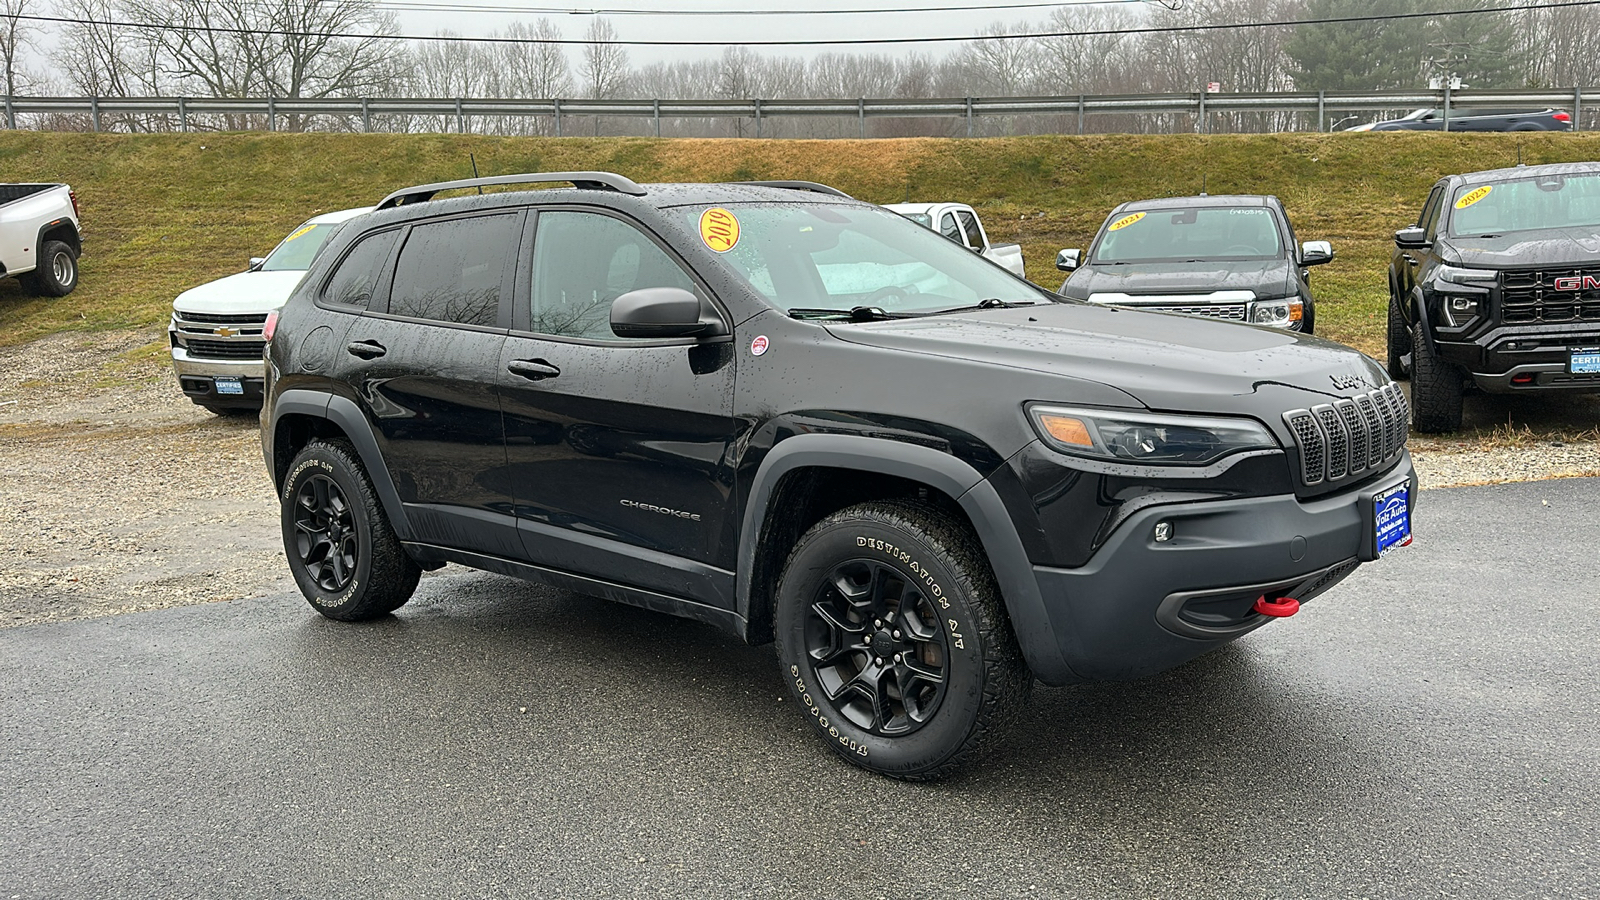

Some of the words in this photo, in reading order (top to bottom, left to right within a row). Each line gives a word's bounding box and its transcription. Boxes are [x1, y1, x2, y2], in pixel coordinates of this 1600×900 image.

[1461, 187, 1487, 206] 2023
[708, 211, 731, 246] 2019
[1115, 213, 1140, 229] 2021
[1329, 374, 1360, 391] Jeep
[321, 461, 334, 473] A/T
[619, 499, 701, 522] CHEROKEE
[1375, 512, 1390, 527] Volz
[1390, 504, 1407, 519] Auto
[856, 536, 951, 610] DESTINATION
[948, 618, 965, 650] A/T
